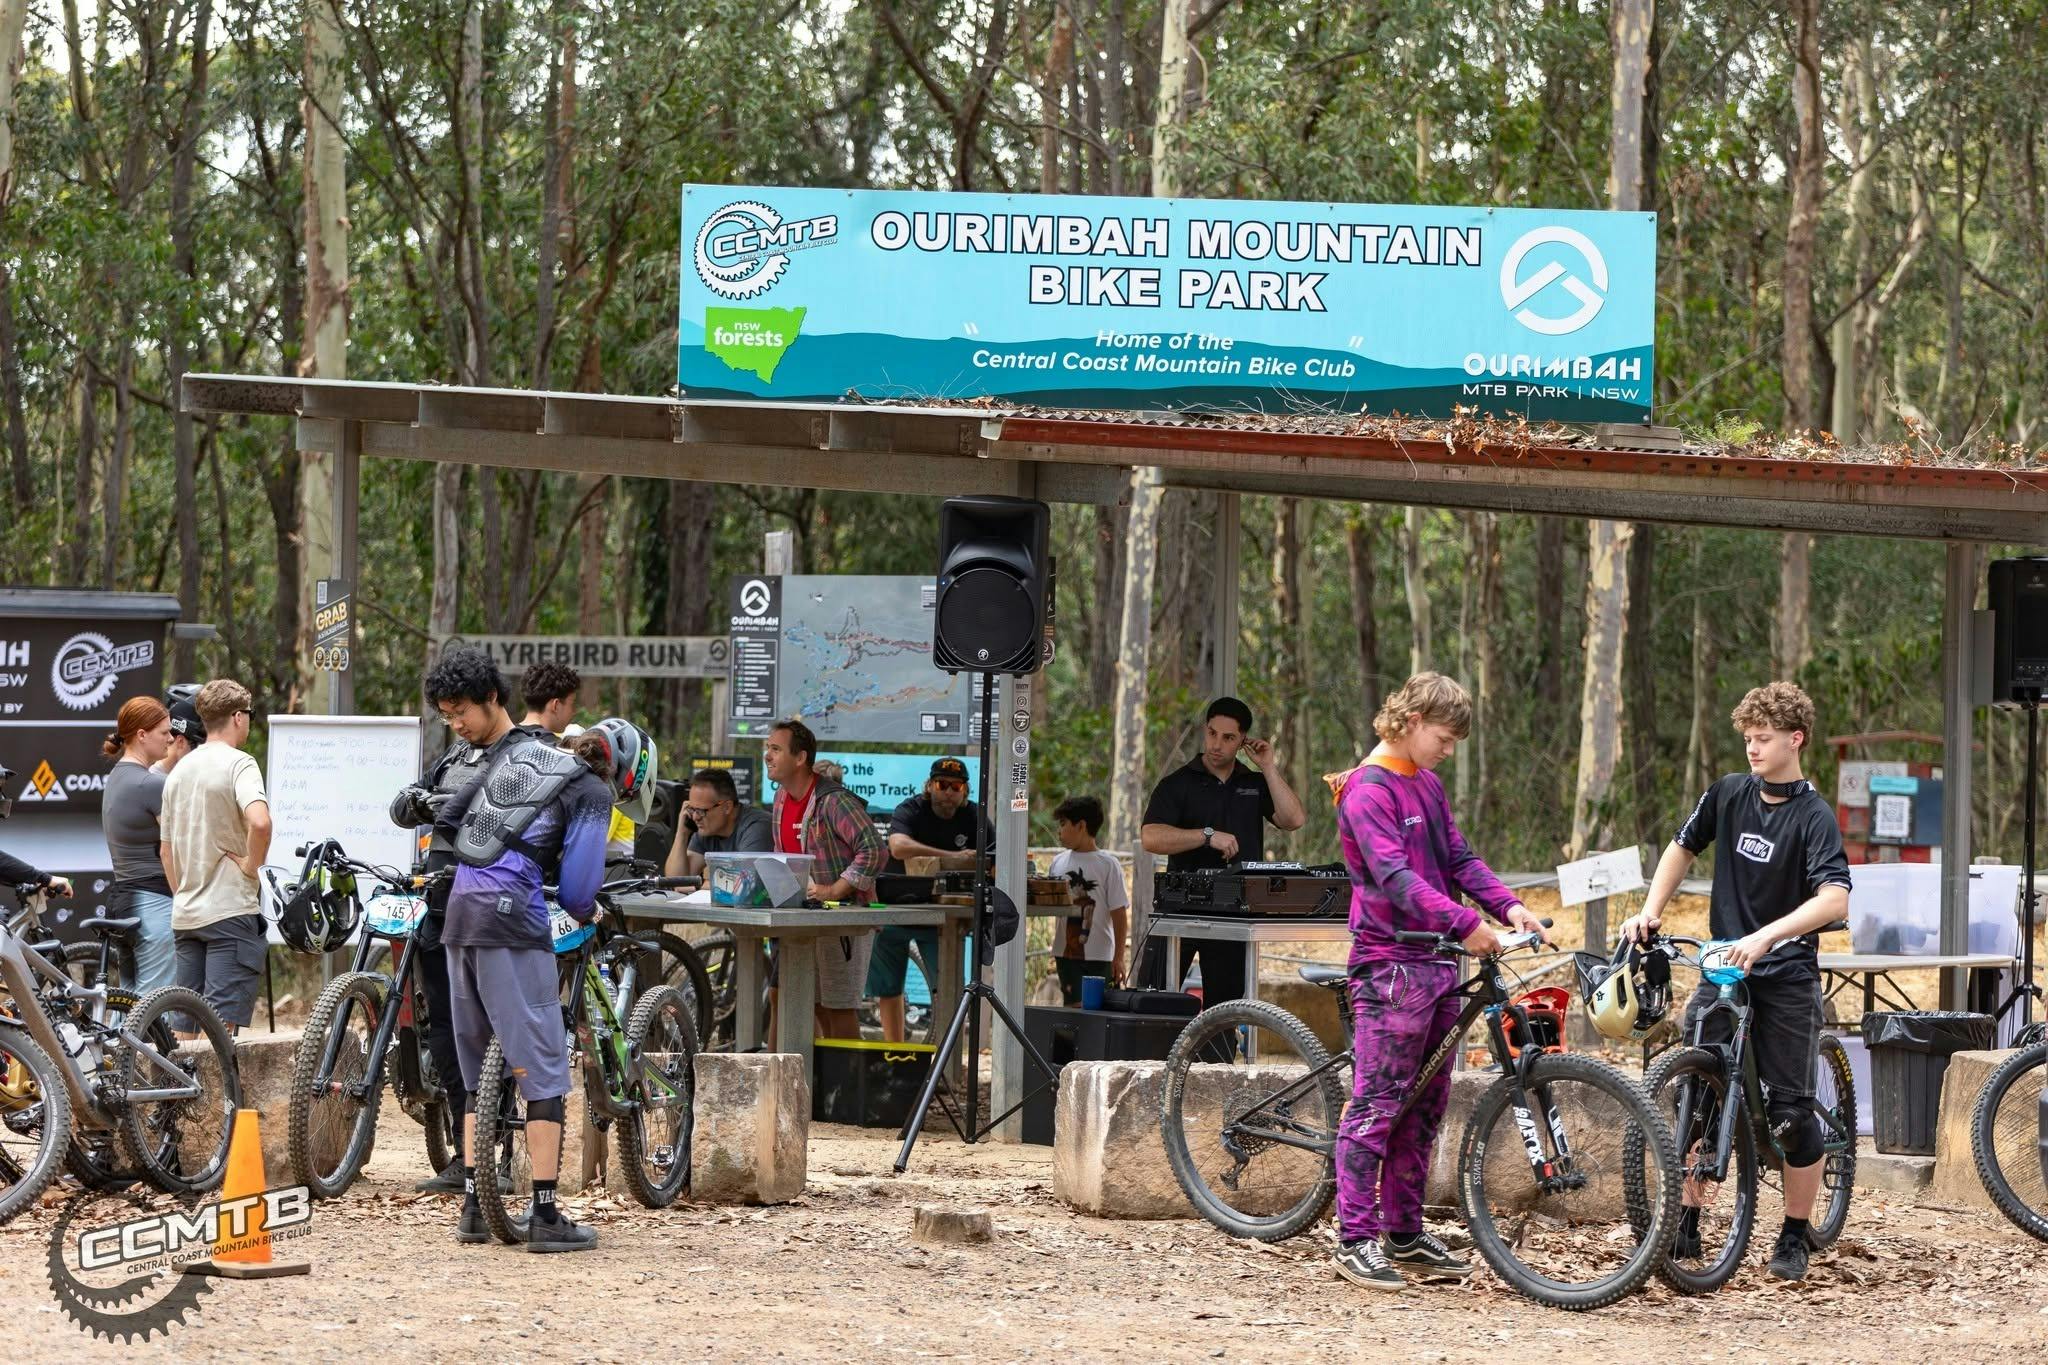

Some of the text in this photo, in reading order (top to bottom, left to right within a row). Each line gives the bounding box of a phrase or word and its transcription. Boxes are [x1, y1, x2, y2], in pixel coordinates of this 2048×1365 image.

[713, 215, 838, 259] CCMTB
[871, 211, 1482, 266] OURIMBAH MOUNTAIN
[1029, 265, 1328, 312] BIKE PARK
[714, 326, 784, 347] forests
[734, 322, 761, 331] nsw
[1095, 329, 1234, 350] Home of the
[972, 349, 1356, 378] Central Coast Mountain Bike Club
[1463, 352, 1641, 380] OURIMBAH
[1463, 384, 1507, 396] MTB
[1516, 385, 1569, 398] PARK
[1591, 388, 1640, 400] NSW
[316, 602, 348, 631] GRAB
[486, 642, 624, 667] LYREBIRD
[629, 644, 686, 667] RUN
[4, 703, 24, 714] BY
[853, 763, 874, 776] the
[880, 783, 917, 796] Track
[1742, 838, 1769, 858] 100%
[387, 906, 406, 919] 145
[558, 920, 572, 936] 66
[108, 996, 134, 1006] AXXI
[1414, 1025, 1461, 1089] DRAKER
[1835, 1048, 1852, 1082] MAXXIS
[1174, 1073, 1185, 1098] SWISS
[1473, 1140, 1486, 1185] DT SWISS
